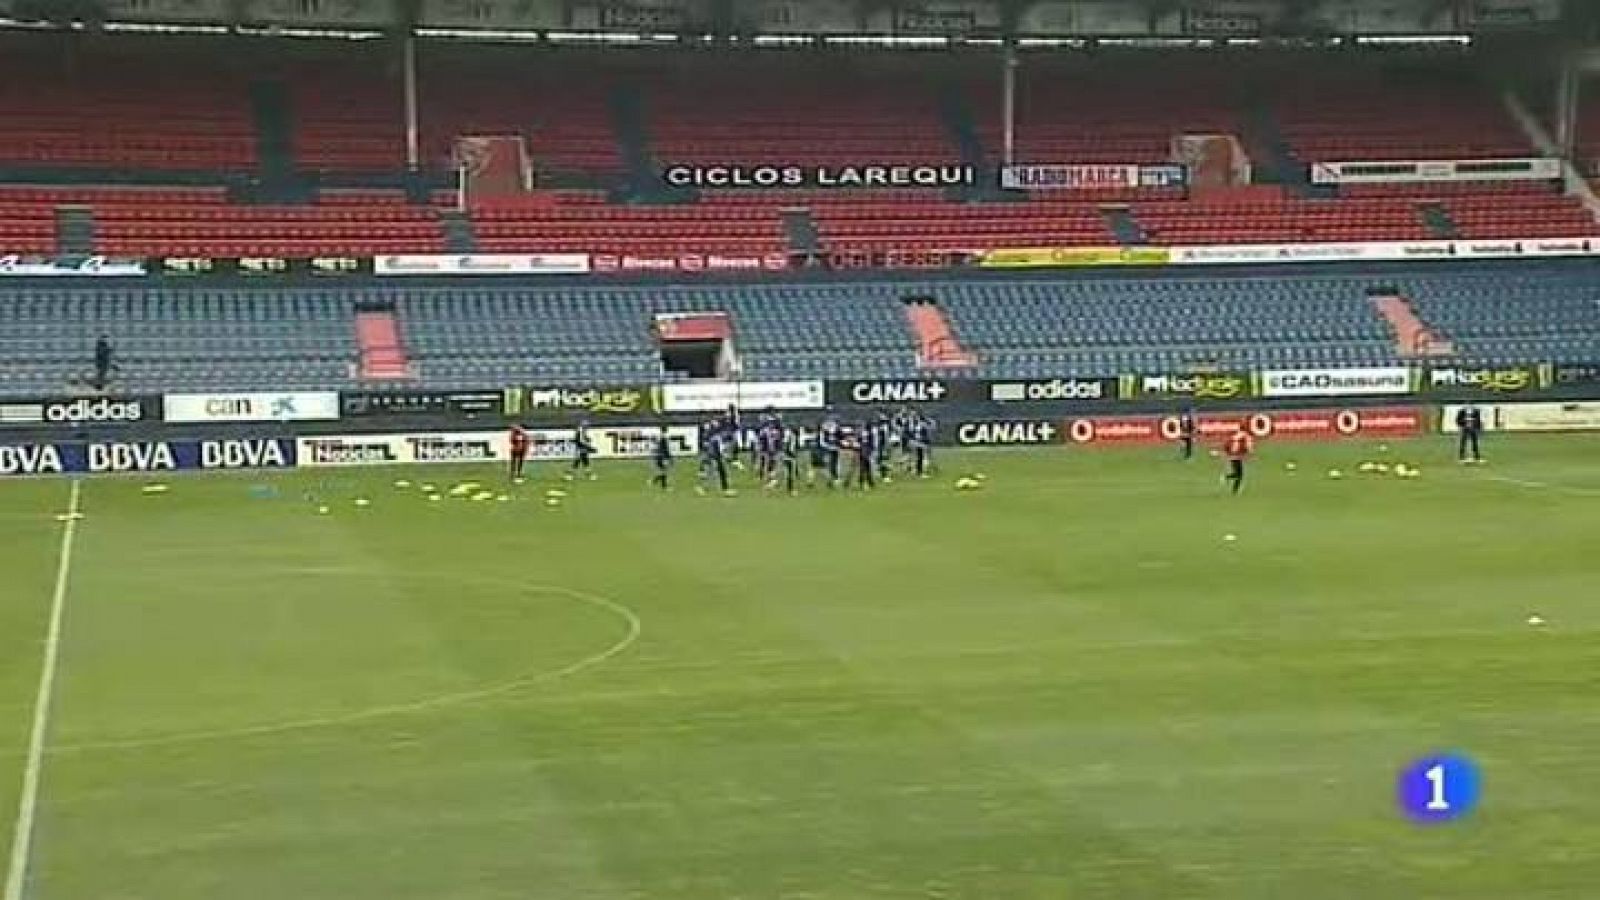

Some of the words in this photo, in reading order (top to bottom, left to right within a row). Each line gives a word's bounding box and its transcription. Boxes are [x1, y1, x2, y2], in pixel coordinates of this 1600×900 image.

[668, 167, 802, 185] CICLOS
[817, 165, 976, 184] LAREQUI
[853, 381, 946, 401] CANAL+
[1028, 379, 1101, 398] adidas
[47, 400, 141, 421] adidas
[960, 421, 1056, 443] CANAL+
[88, 442, 175, 471] BBVA
[200, 438, 286, 467] BBVA
